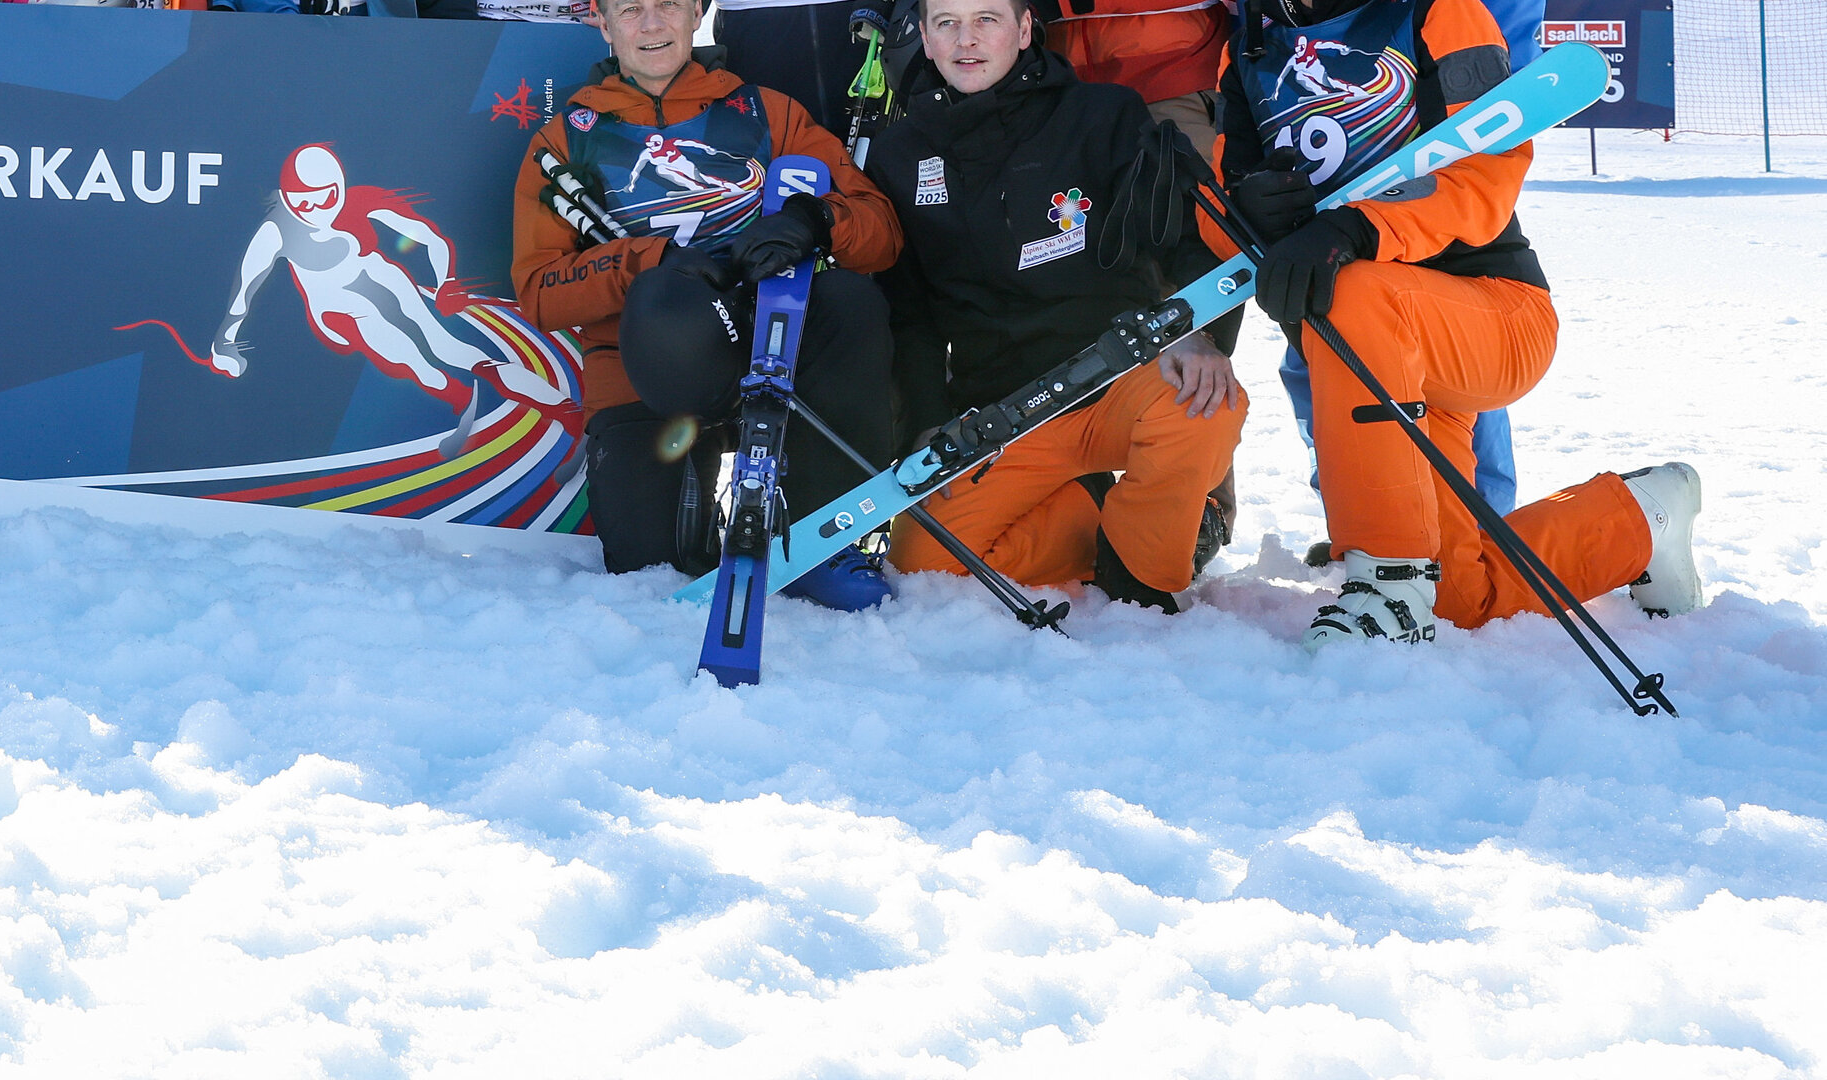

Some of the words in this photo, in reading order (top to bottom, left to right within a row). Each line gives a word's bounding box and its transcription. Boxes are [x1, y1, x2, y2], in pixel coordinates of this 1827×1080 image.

[1547, 23, 1619, 42] saalbach
[544, 78, 553, 114] Austria
[1328, 100, 1524, 209] EAD
[917, 192, 947, 204] 2025
[1022, 244, 1043, 256] Alpine
[1045, 241, 1056, 249] Ski
[1058, 235, 1071, 245] WM
[1023, 252, 1049, 263] Saalbach
[711, 299, 740, 343] uvex
[1147, 320, 1160, 331] 14
